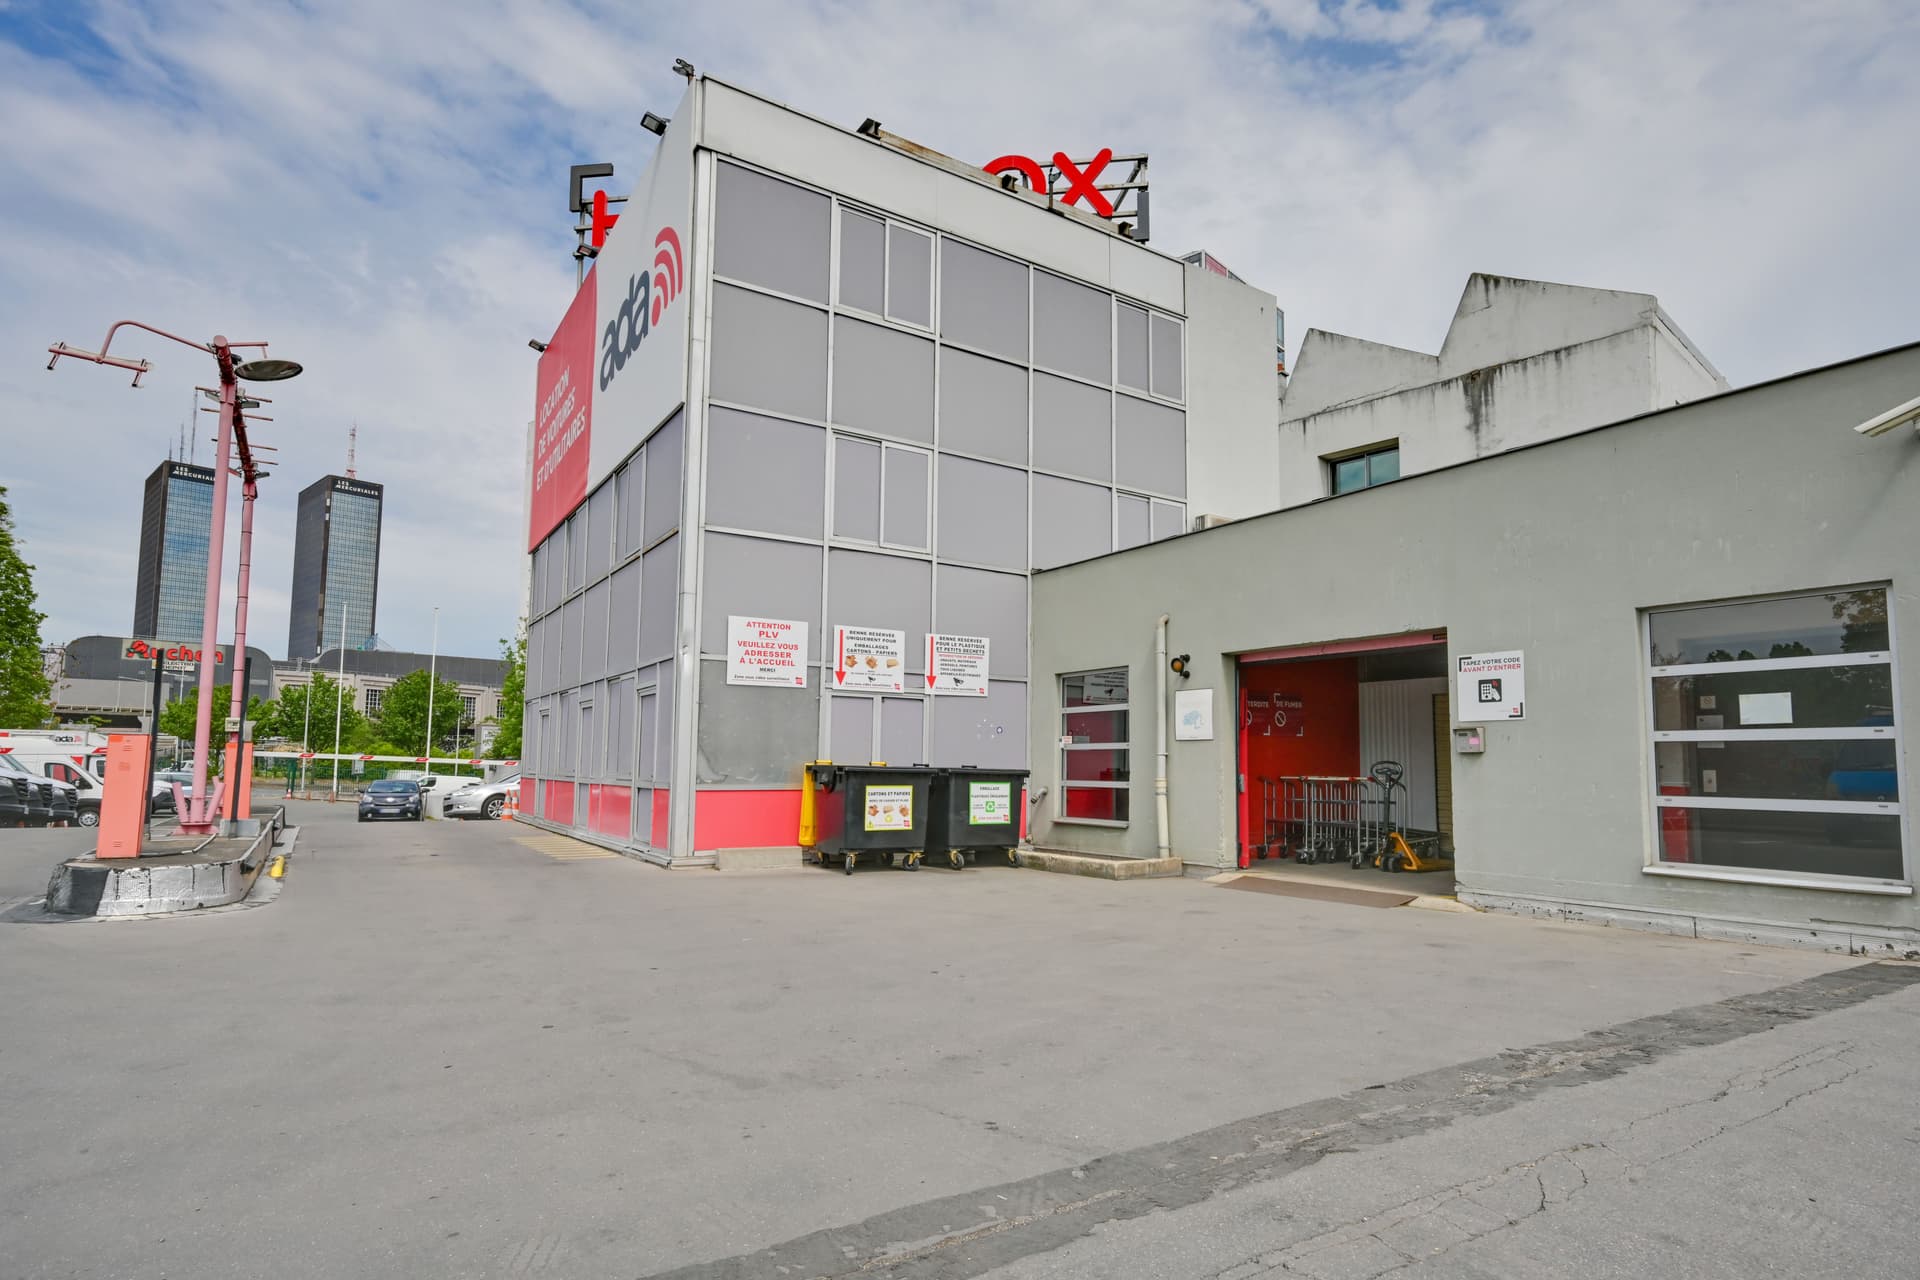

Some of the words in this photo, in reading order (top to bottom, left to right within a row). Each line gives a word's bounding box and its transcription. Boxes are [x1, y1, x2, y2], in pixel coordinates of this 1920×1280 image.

[599, 269, 650, 392] ada
[539, 366, 570, 428] LOCATION
[537, 435, 547, 460] DE
[547, 386, 576, 446] VOITURES
[172, 470, 216, 481] MERCURIAL
[536, 465, 545, 492] ET
[335, 484, 379, 496] MERCURIALES
[746, 621, 791, 630] ATTENTION
[758, 630, 779, 638] PLV
[737, 640, 775, 649] VEUILLEZ
[744, 649, 792, 658] ADRESSER
[748, 658, 796, 667] L'ACCUEIL
[1487, 663, 1521, 672] D'ENTRER
[1247, 700, 1269, 708] TERDITE
[54, 735, 74, 743] ada
